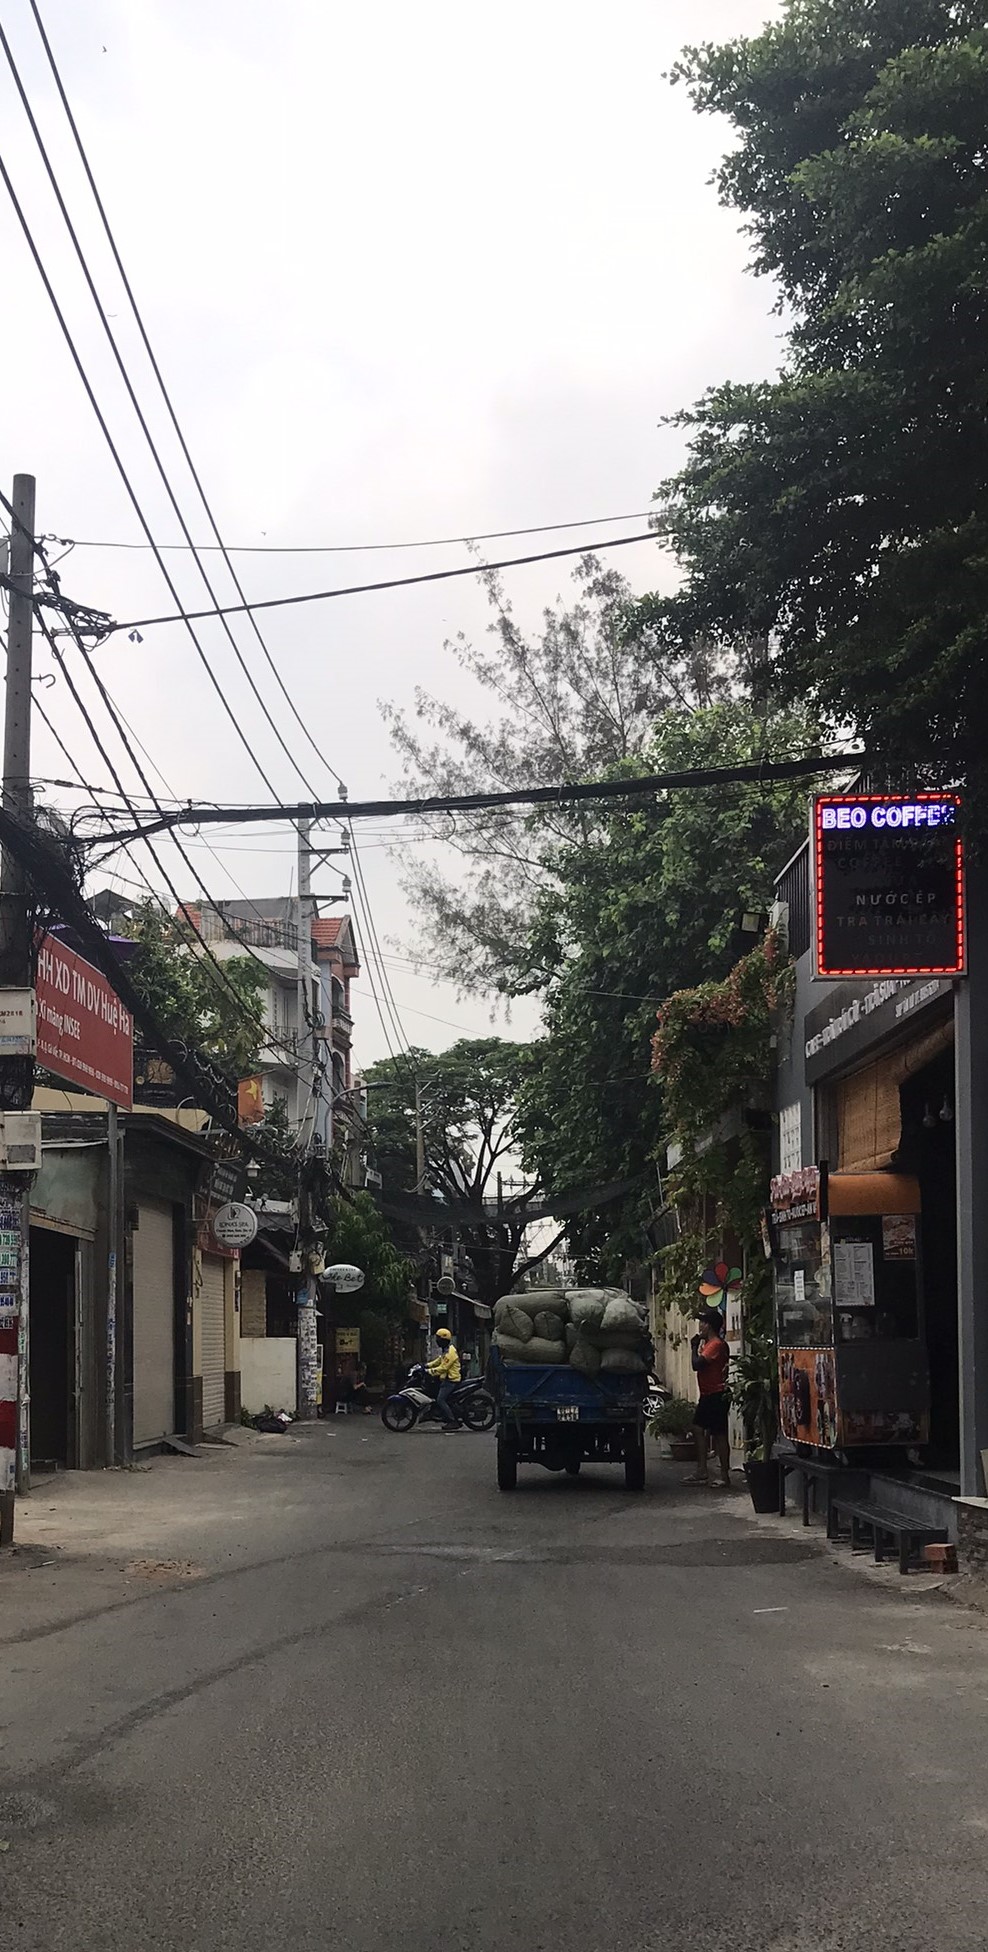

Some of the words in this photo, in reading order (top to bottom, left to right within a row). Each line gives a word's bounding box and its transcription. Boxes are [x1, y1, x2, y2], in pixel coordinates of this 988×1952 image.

[822, 806, 866, 829] BEO
[856, 890, 909, 905] NƯỚC
[916, 889, 936, 904] ÉP
[868, 934, 909, 946] SINH
[55, 958, 70, 994] XD
[73, 971, 86, 1007] TM
[88, 982, 102, 1015] DV
[101, 991, 119, 1035] Huệ
